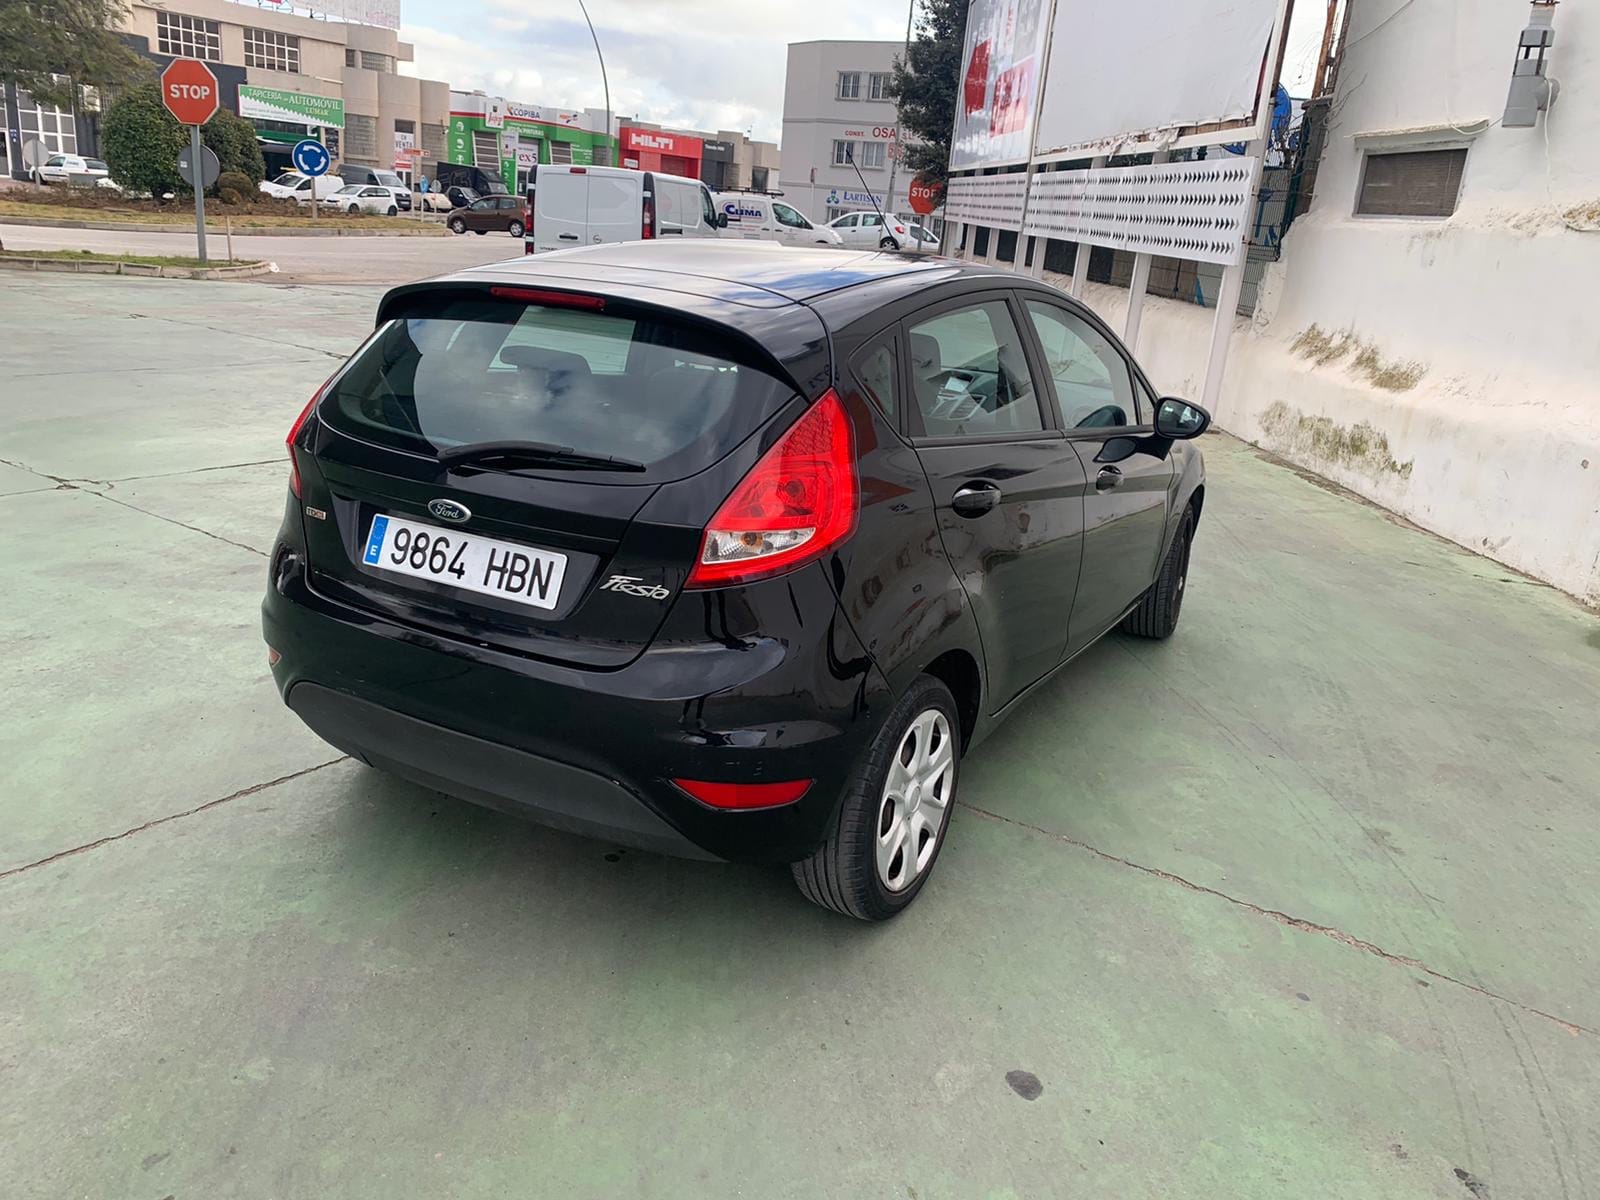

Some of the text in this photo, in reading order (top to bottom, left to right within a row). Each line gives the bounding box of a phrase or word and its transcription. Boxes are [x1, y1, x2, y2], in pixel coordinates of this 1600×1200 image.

[169, 84, 210, 99] STOP
[513, 107, 540, 119] COPIBA
[872, 126, 896, 139] OSA
[631, 133, 673, 150] HILTI
[435, 503, 460, 519] Ford
[369, 544, 378, 557] E
[391, 527, 555, 600] 9864 HBN
[600, 575, 670, 600] Fiesta
